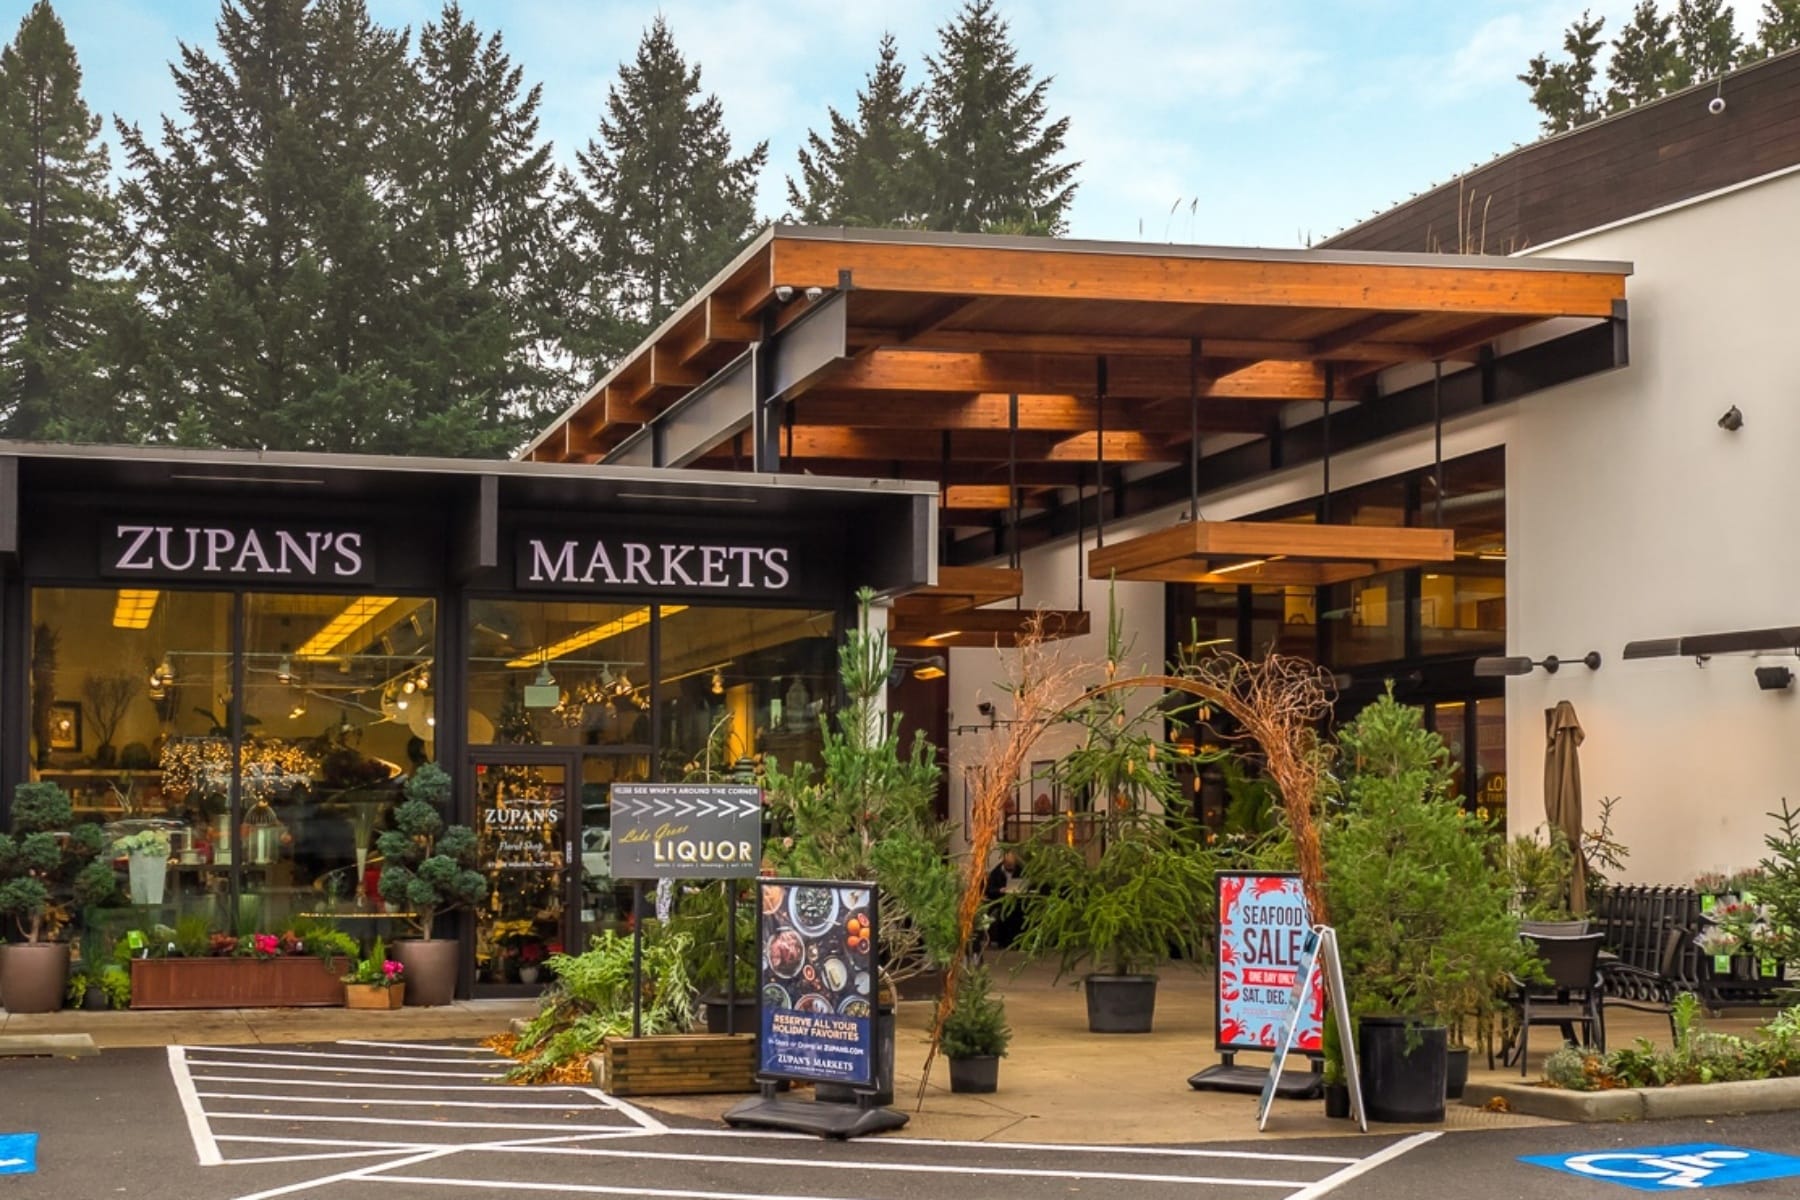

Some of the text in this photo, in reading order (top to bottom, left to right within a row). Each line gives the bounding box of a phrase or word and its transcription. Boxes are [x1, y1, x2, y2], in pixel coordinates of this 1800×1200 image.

[115, 525, 789, 589] ZUPAN'S MARKETS
[485, 808, 559, 824] ZUPAN'S
[653, 840, 753, 862] LIQUOR
[1242, 905, 1302, 926] SEAFOOD
[1243, 927, 1302, 966] SALE
[1248, 971, 1263, 983] ONE
[1264, 972, 1278, 983] DAY
[1242, 987, 1288, 1005] SAT., DEC.
[774, 1015, 857, 1032] RESERVE ALL YOUR
[773, 1024, 858, 1041] HOLIDAY FAVORITES
[778, 1054, 810, 1066] ZUPAN'S
[814, 1058, 854, 1071] MARKETS
